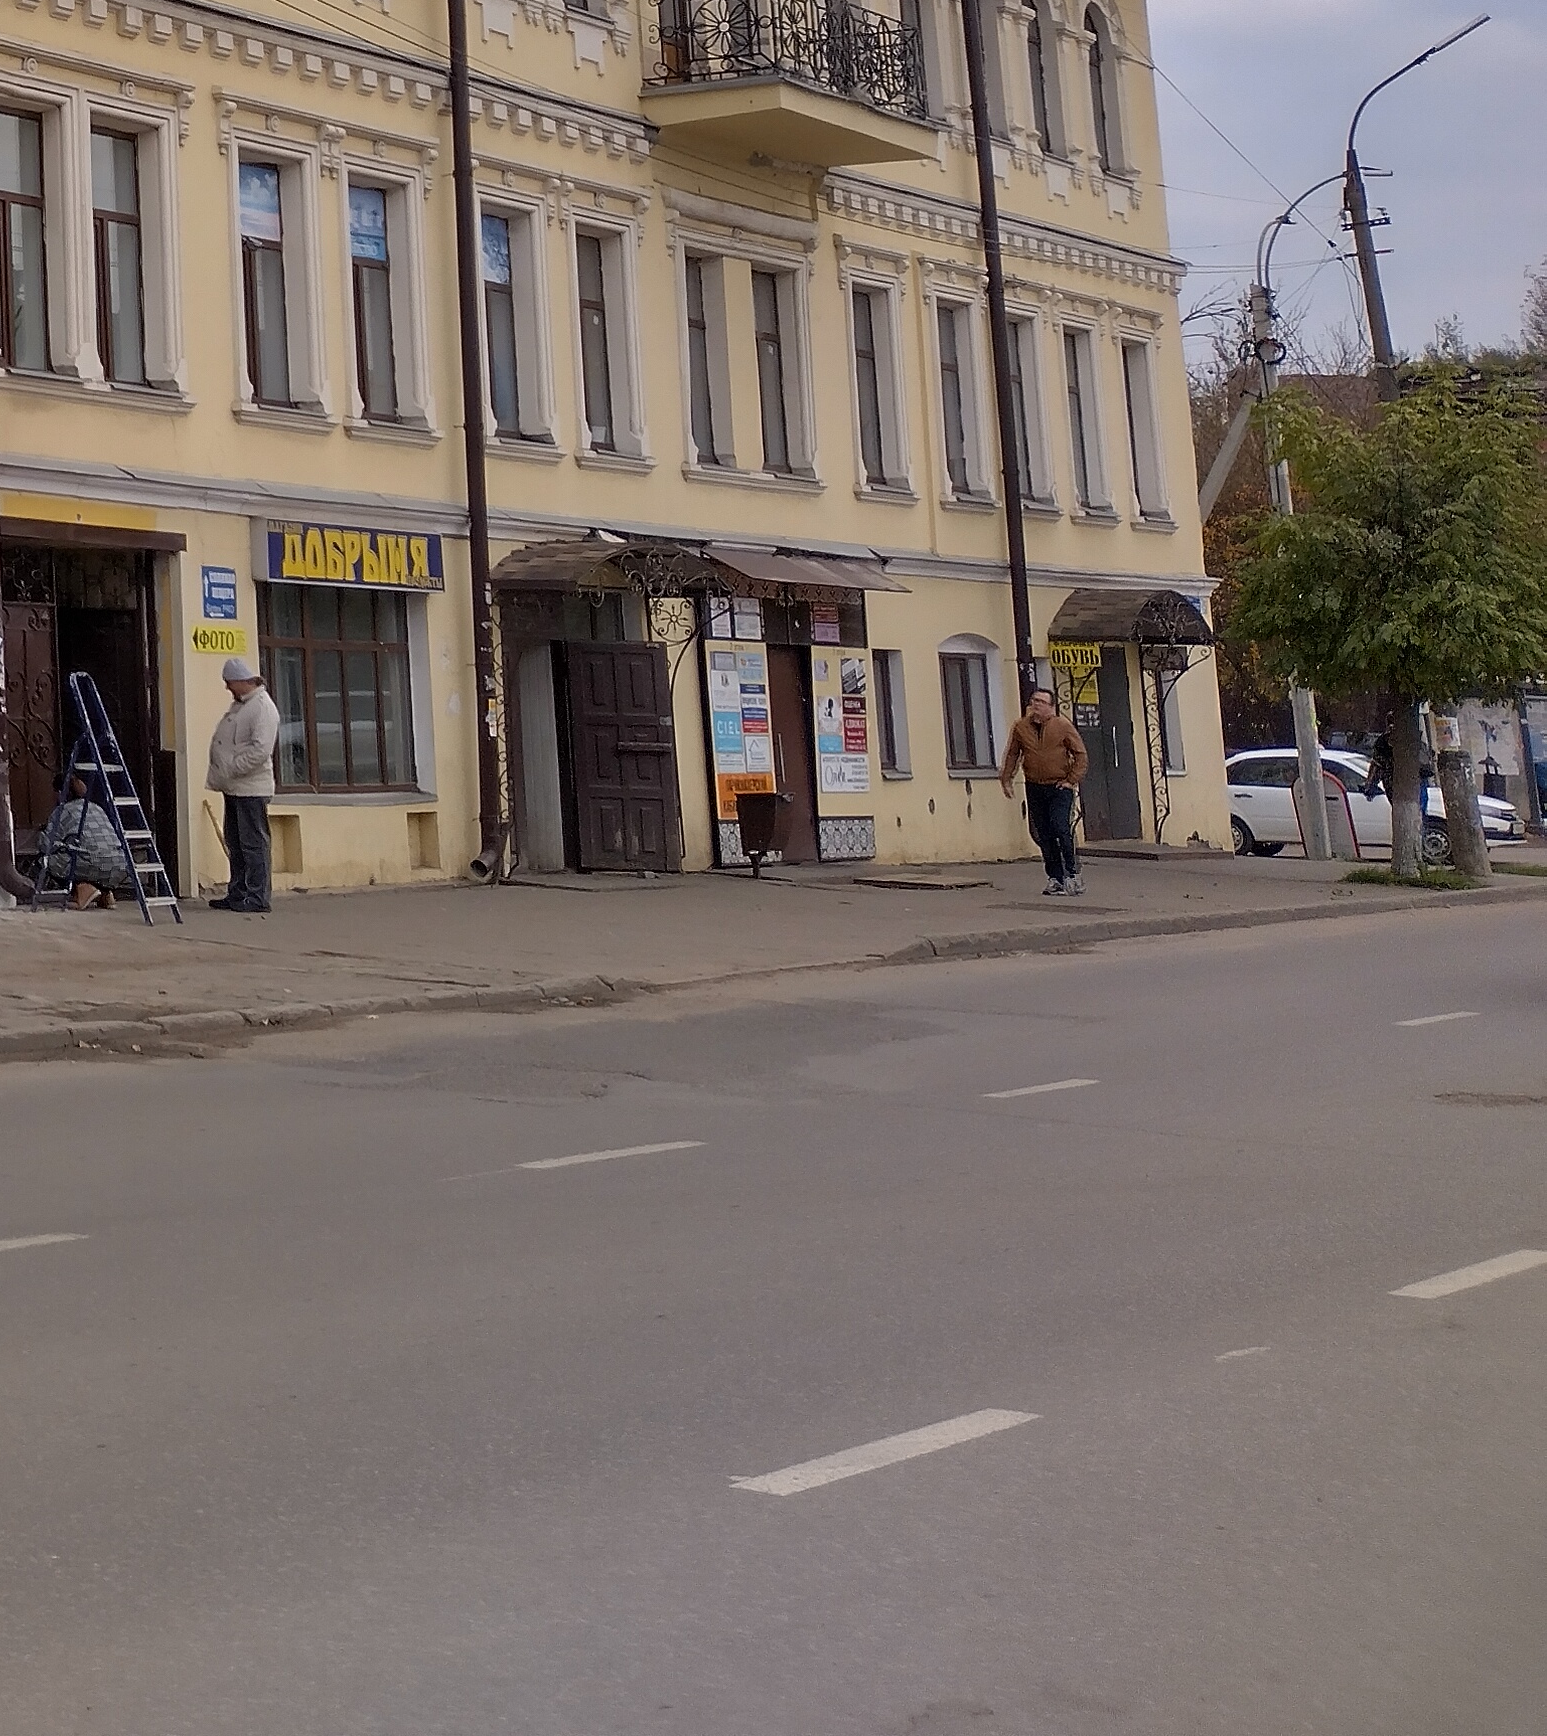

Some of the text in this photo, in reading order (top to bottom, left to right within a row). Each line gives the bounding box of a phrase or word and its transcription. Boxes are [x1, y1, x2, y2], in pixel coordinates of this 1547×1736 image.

[282, 527, 430, 585] ДОБРЫНЯ
[199, 630, 235, 651] ФОТО
[1051, 648, 1100, 665] ОБУВЬ
[717, 720, 741, 735] CIEL
